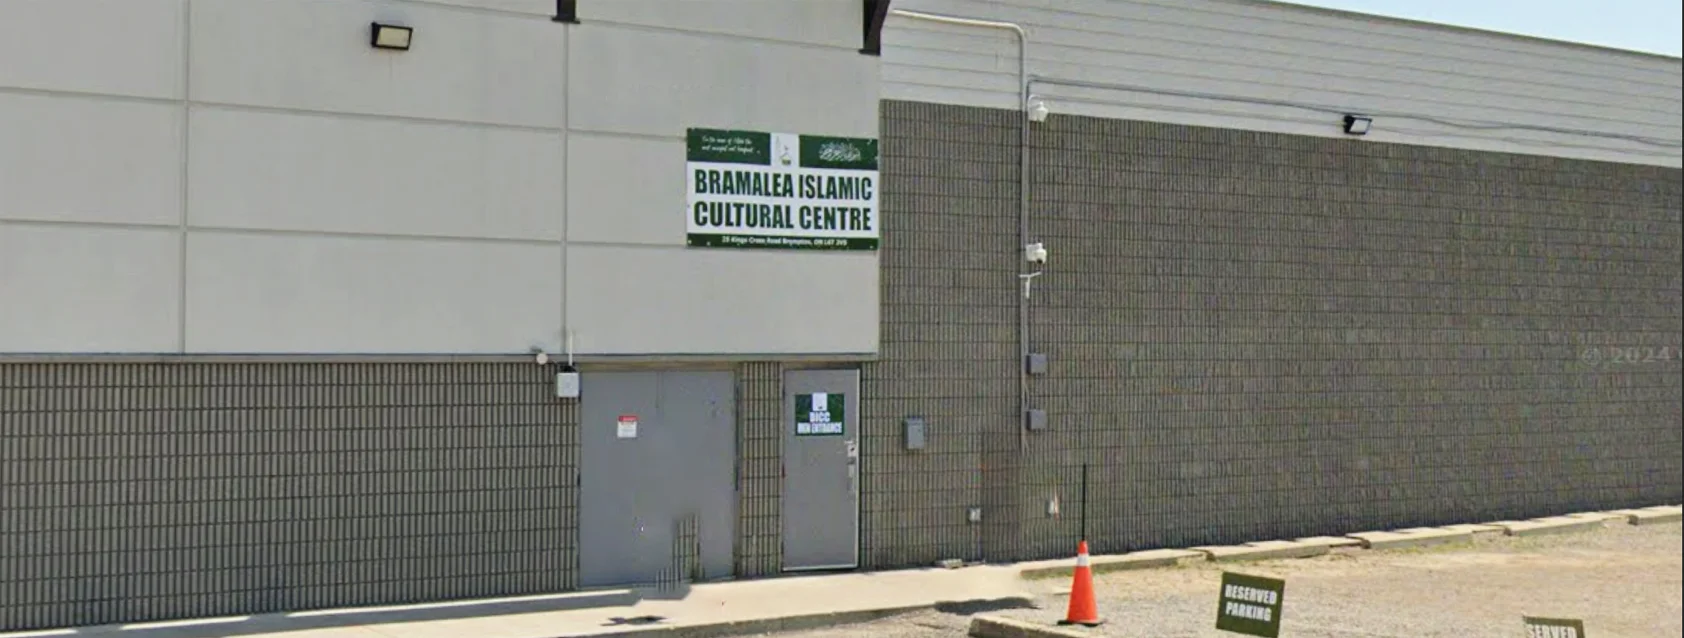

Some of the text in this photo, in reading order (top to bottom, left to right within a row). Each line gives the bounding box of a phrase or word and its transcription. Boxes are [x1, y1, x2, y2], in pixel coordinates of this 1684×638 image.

[695, 169, 872, 201] BRAMALEA ISLAMIC
[694, 201, 871, 231] CULTURAL CENTRE
[811, 423, 842, 434] ENTRANCE
[1225, 584, 1277, 605] RESERVED
[1225, 602, 1272, 621] PARKING
